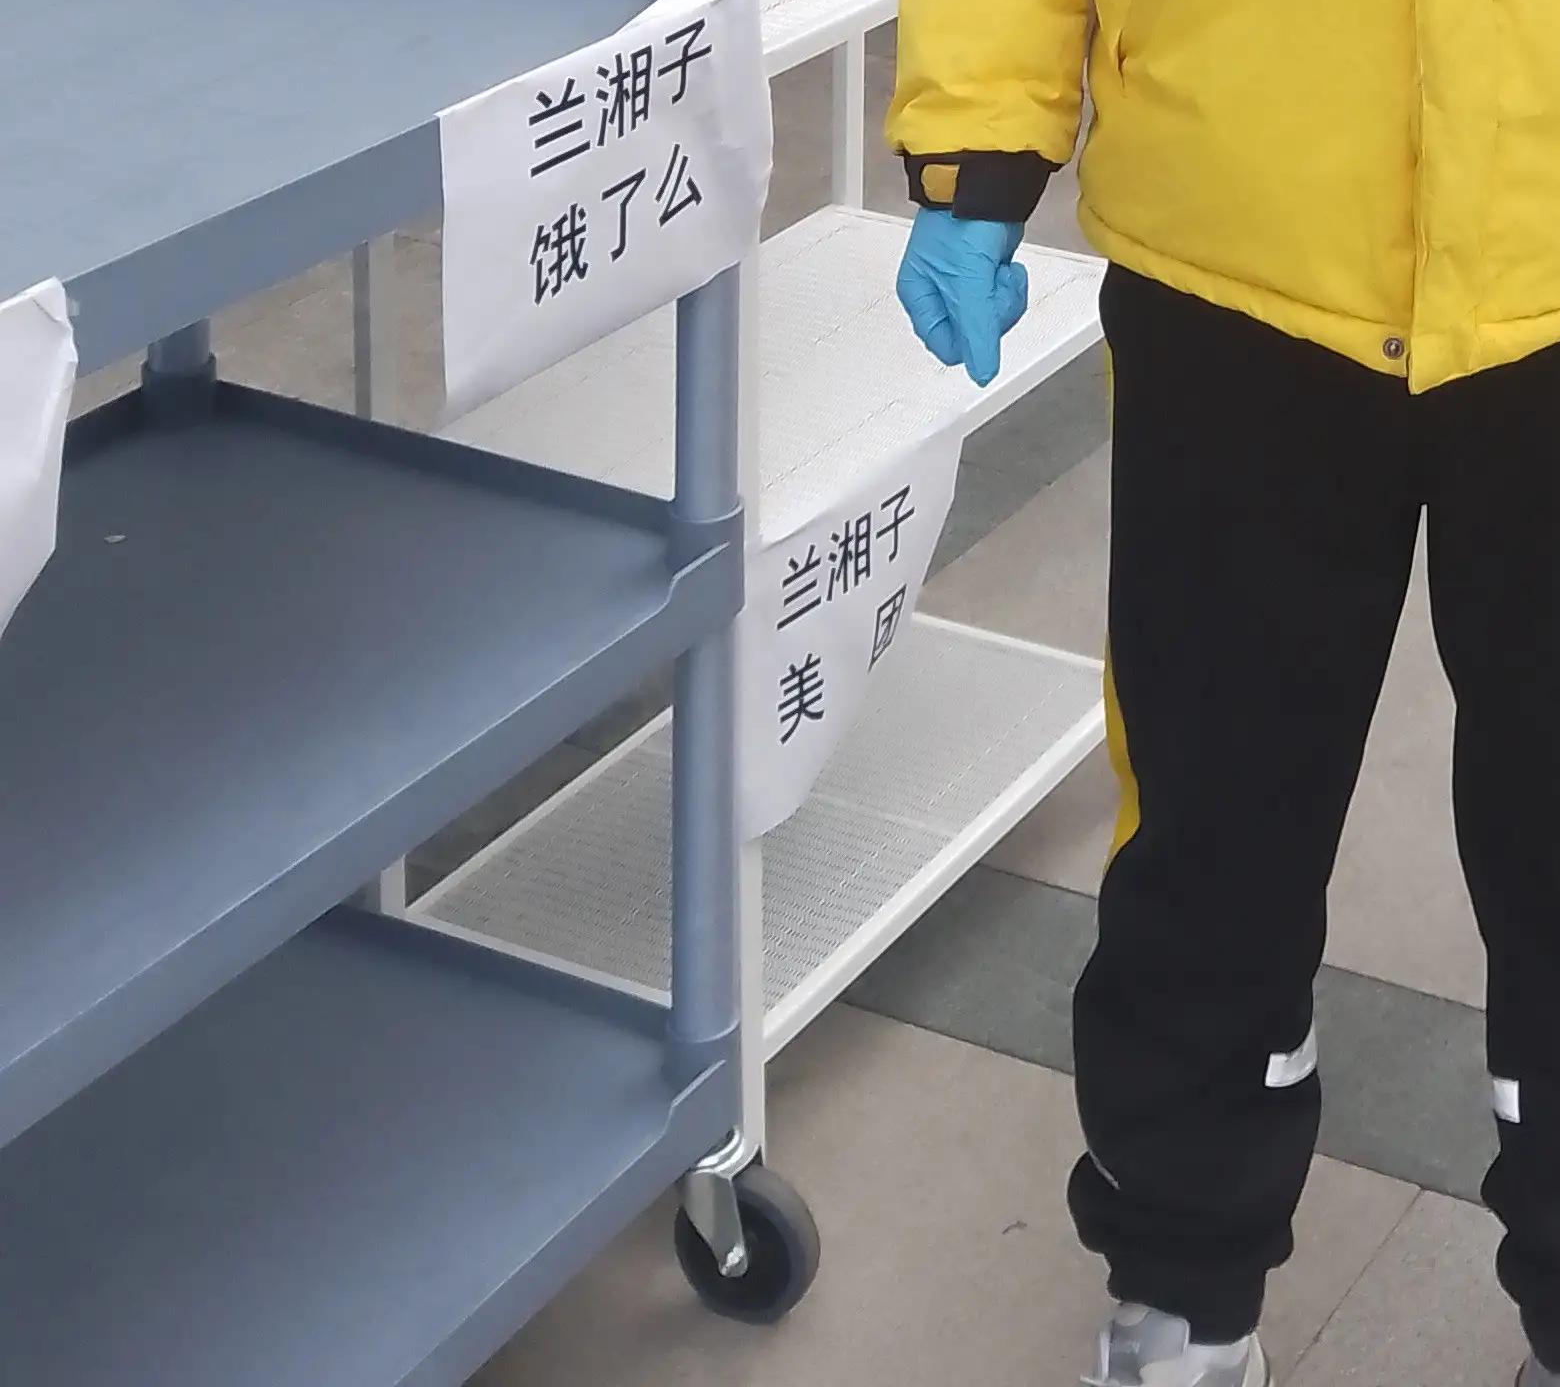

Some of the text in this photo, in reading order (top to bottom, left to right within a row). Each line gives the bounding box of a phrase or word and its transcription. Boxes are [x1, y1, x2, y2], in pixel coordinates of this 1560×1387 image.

[528, 19, 713, 178] 兰湘子
[528, 143, 704, 306] 饿了么
[776, 484, 915, 630] 兰湘子
